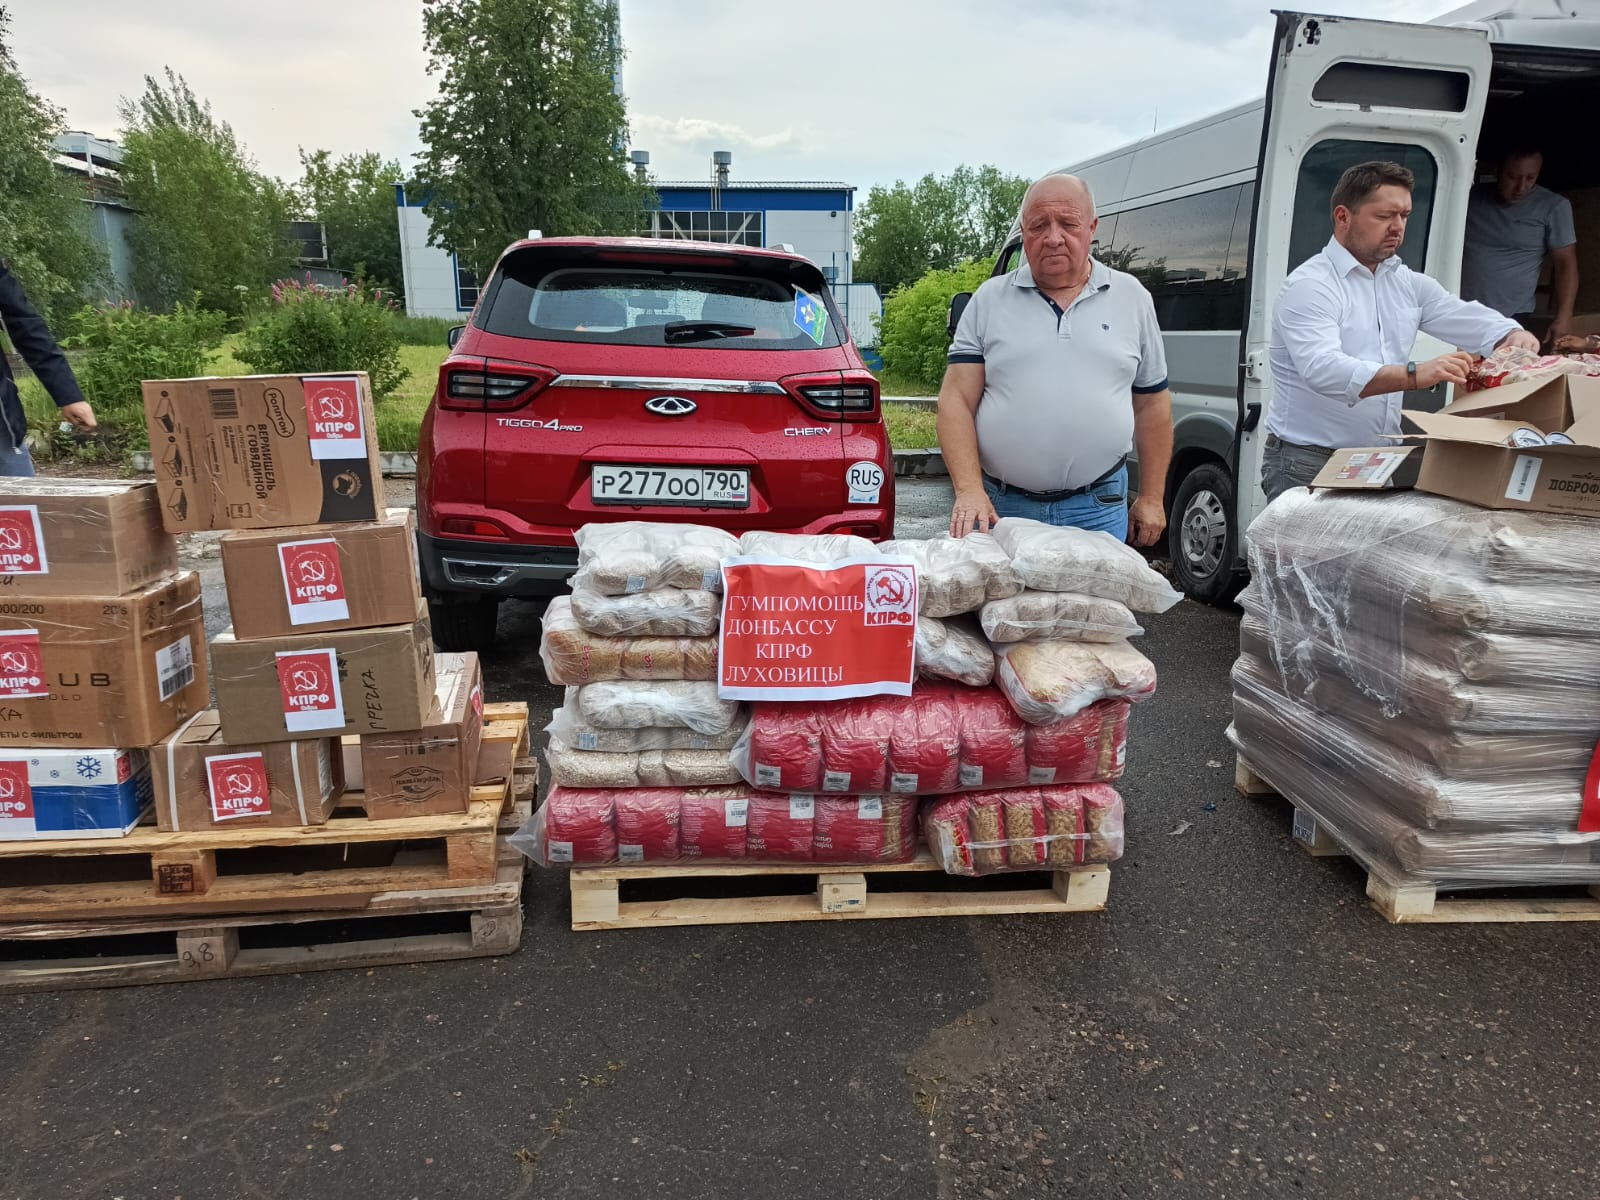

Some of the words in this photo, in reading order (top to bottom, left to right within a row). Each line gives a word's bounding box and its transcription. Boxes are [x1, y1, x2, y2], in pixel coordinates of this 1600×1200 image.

[314, 421, 356, 433] КПРФ
[784, 427, 832, 436] CHERY
[258, 424, 276, 490] ВЕРМИШЕЛЬ
[247, 434, 268, 499] ГОВЯДИНОЙ
[704, 472, 741, 491] 790
[851, 469, 881, 486] RUS
[1548, 478, 1600, 496] ДОБРОФ
[713, 491, 732, 499] RUS
[296, 584, 338, 598] КПРФ
[0, 603, 45, 614] 00/200
[728, 595, 864, 613] ГУМПОМОЩЬ
[866, 611, 912, 624] КПРФ
[726, 619, 838, 636] ДОНБАССУ
[755, 643, 813, 659] КПРФ
[0, 676, 40, 688] КПРФ
[46, 673, 111, 687] UB
[725, 666, 844, 685] ЛУХОВИЦЫ
[288, 693, 330, 706] КПРФ
[31, 731, 83, 739] ФИЛЬТРОМ
[222, 795, 264, 809] КПРФ
